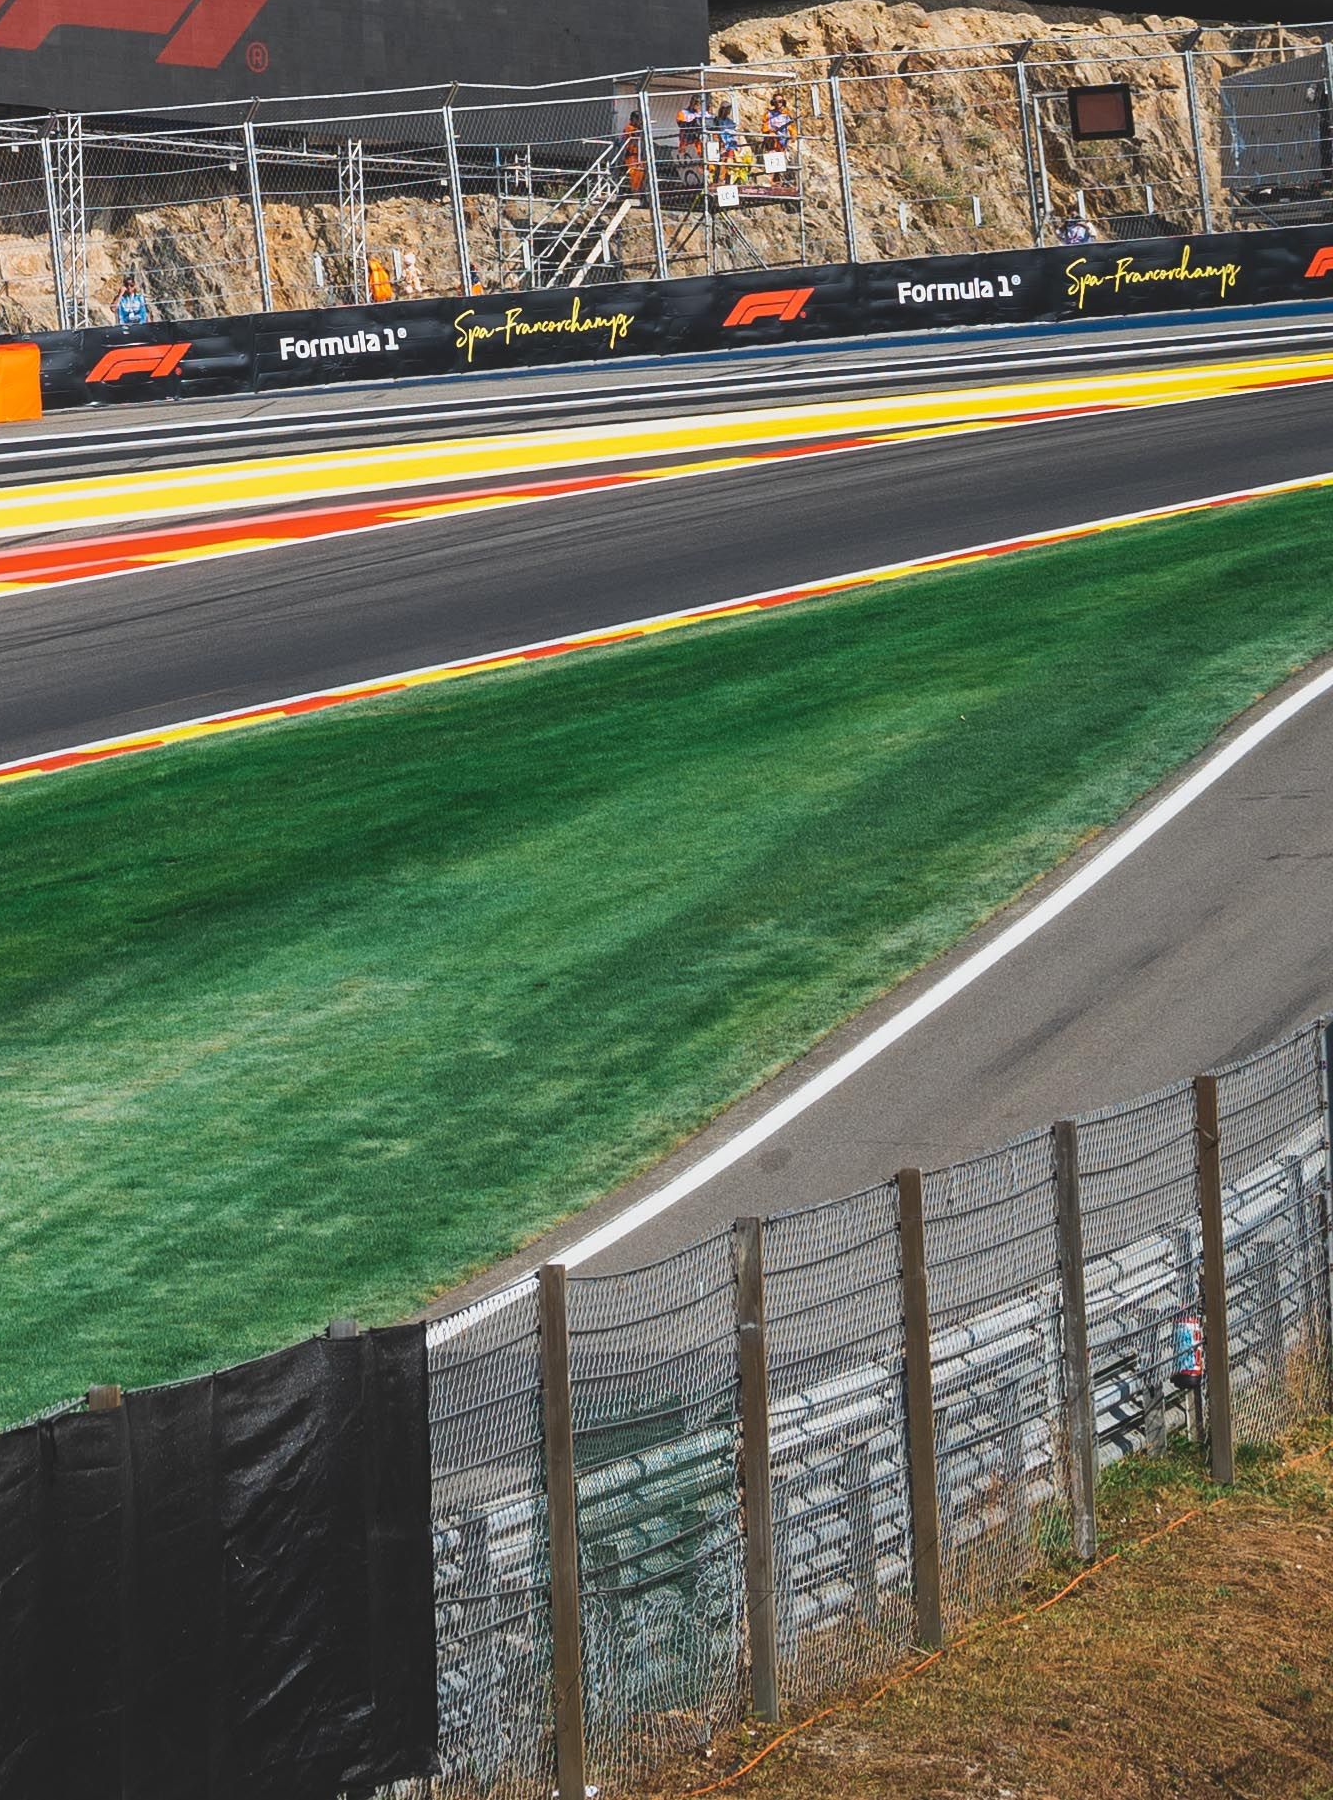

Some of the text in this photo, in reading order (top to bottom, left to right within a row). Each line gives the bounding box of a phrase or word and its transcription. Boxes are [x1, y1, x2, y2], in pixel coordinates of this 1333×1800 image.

[896, 278, 995, 305] Formula
[1064, 244, 1241, 310] Spa-Francorchamps
[723, 287, 815, 327] F1
[279, 330, 381, 361] Formula
[454, 297, 635, 362] Spa-Francorchamps
[85, 342, 193, 383] F1
